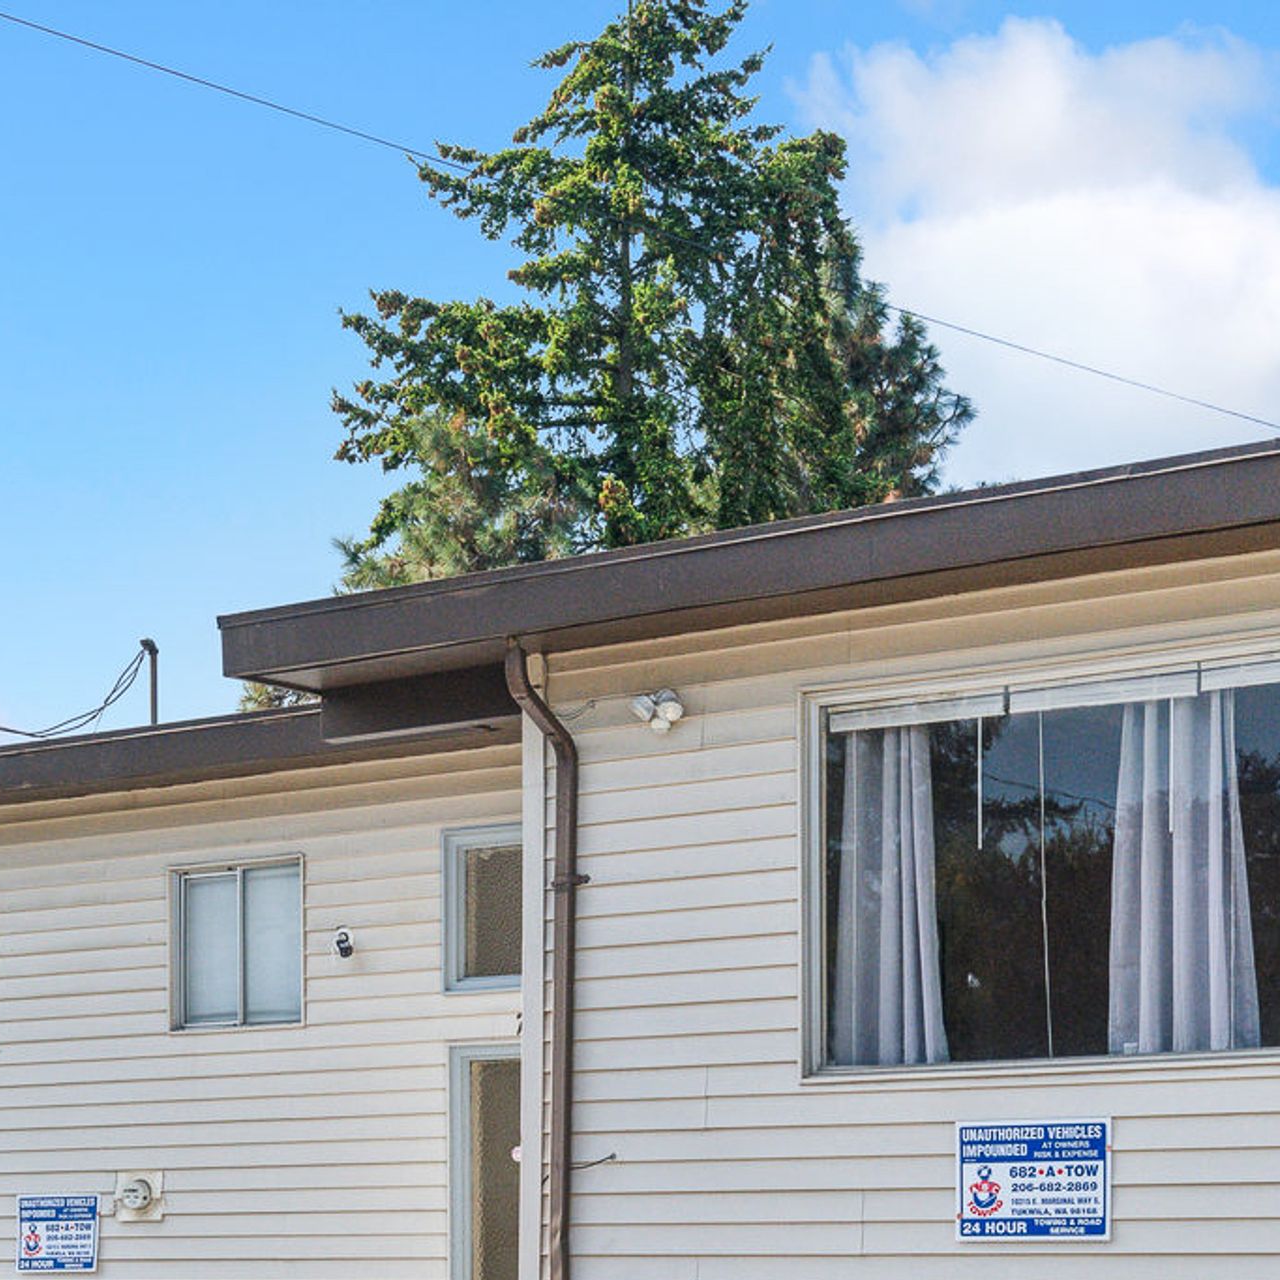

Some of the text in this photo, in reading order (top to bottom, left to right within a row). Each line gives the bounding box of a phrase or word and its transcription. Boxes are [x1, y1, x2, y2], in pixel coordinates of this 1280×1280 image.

[962, 1125, 1102, 1142] UNAUTHORIZED VEHICLES
[962, 1144, 1028, 1158] IMPOUNDED
[1063, 1149, 1099, 1158] EXPENSE
[962, 1221, 1028, 1234] 24 HOUR
